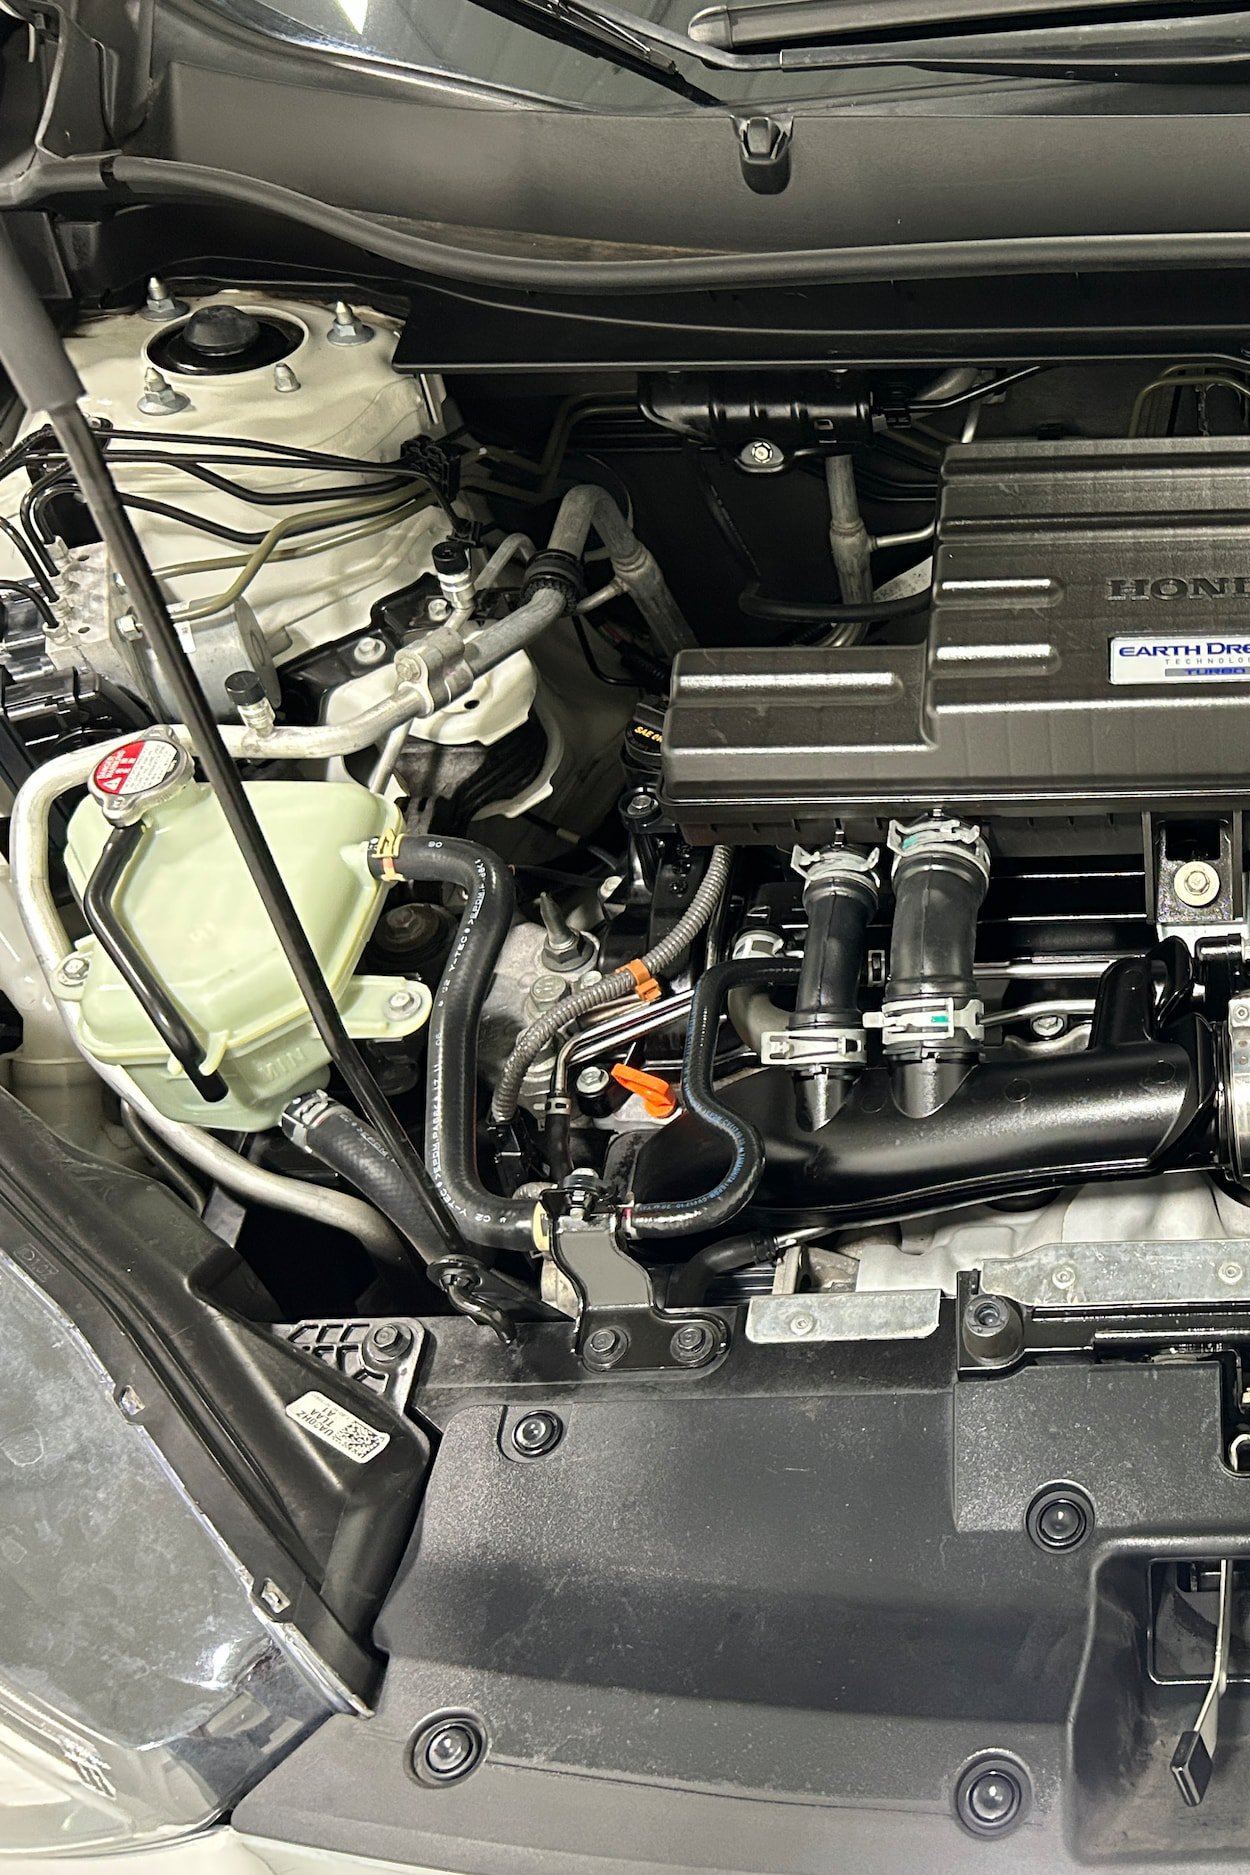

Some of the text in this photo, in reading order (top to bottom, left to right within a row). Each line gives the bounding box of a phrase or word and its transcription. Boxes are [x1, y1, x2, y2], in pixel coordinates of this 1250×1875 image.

[1119, 644, 1201, 657] EARTH
[1184, 667, 1247, 676] TURBO
[310, 1408, 335, 1427] TLAA
